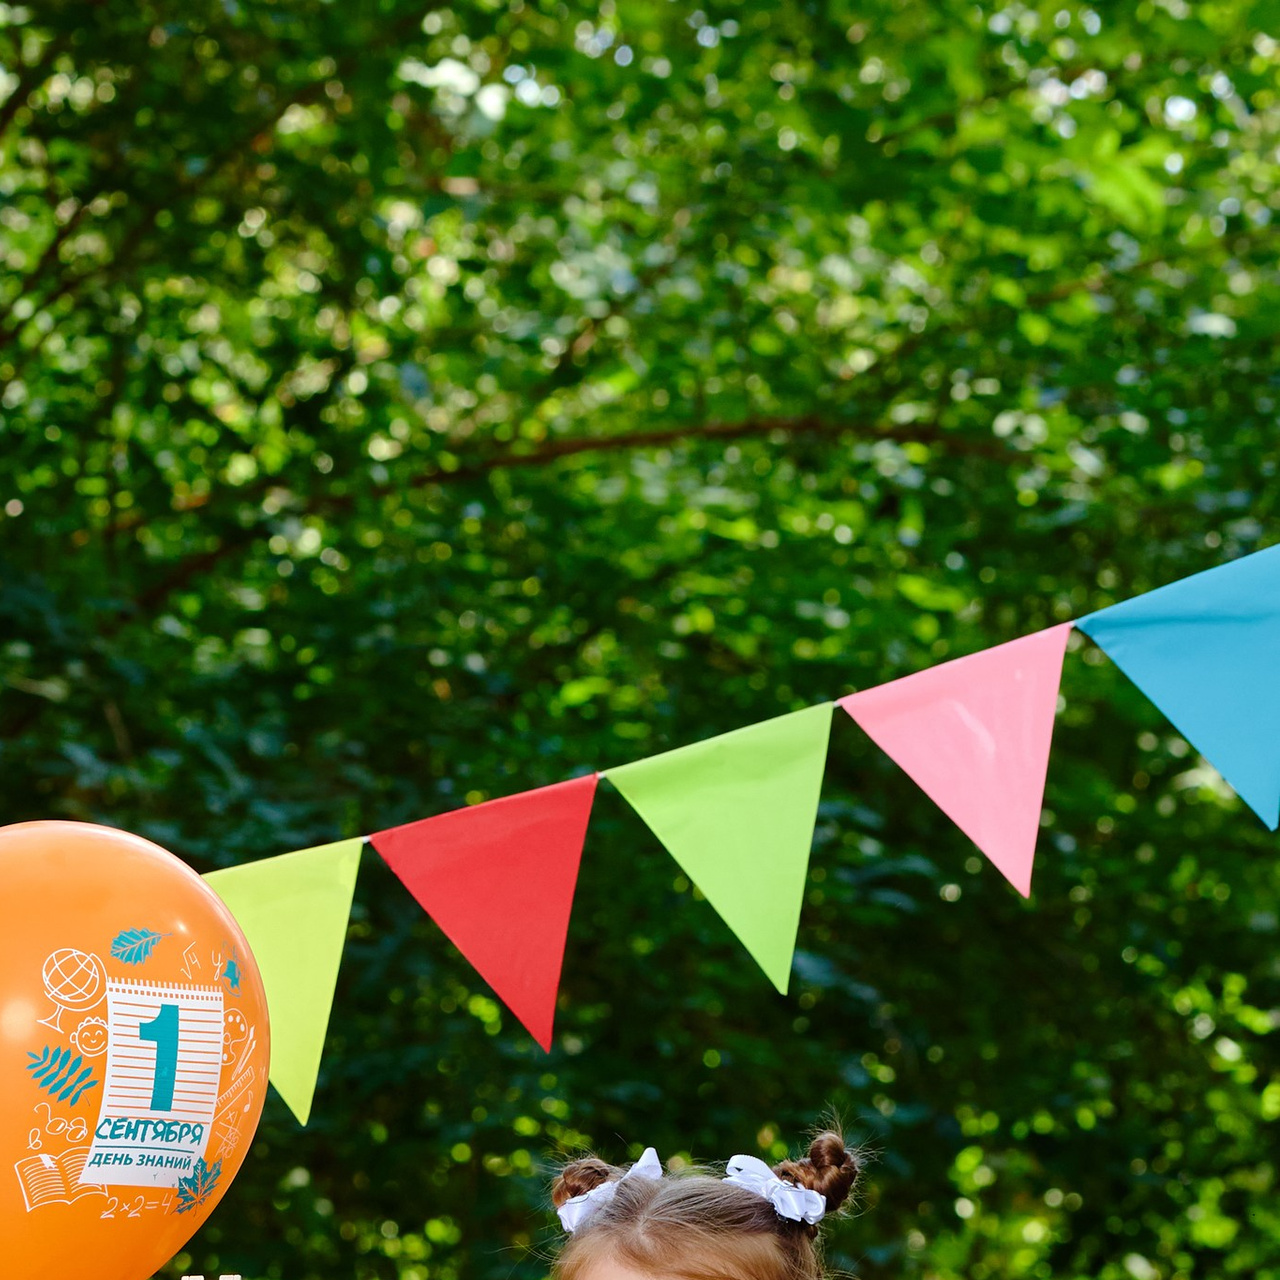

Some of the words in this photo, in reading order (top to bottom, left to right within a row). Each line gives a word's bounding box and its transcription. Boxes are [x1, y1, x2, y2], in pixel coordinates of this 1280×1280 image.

[139, 1003, 179, 1112] 1
[94, 1117, 204, 1146] СЕНТЯБРЯ
[88, 1152, 133, 1167] ДЕНЬ
[136, 1153, 192, 1170] ЗНАНИЙ
